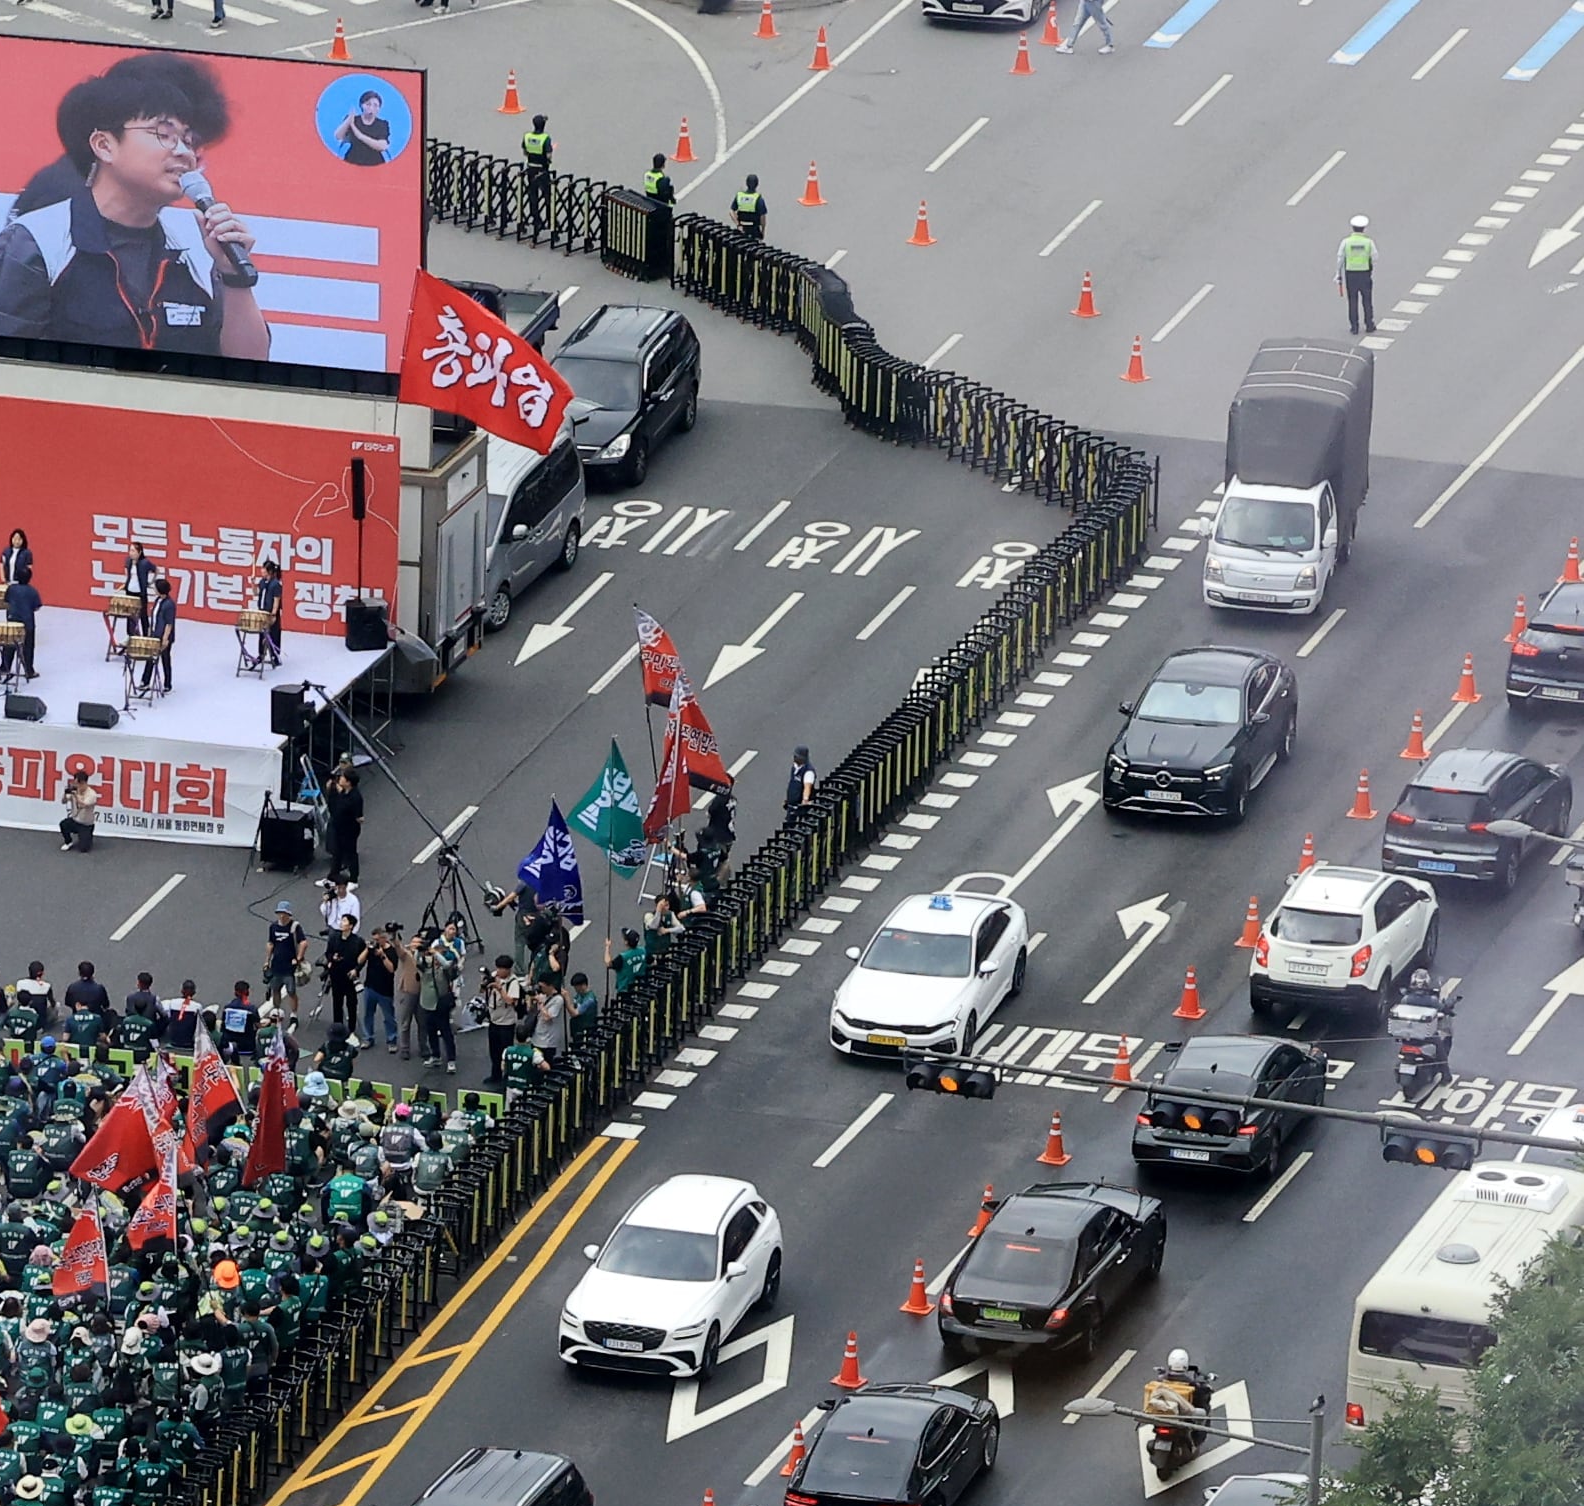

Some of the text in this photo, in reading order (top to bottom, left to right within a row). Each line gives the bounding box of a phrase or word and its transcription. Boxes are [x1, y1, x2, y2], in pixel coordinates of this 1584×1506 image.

[422, 304, 555, 428] 총파업
[91, 514, 334, 575] 모든 노동자의
[90, 560, 263, 613] 노기본
